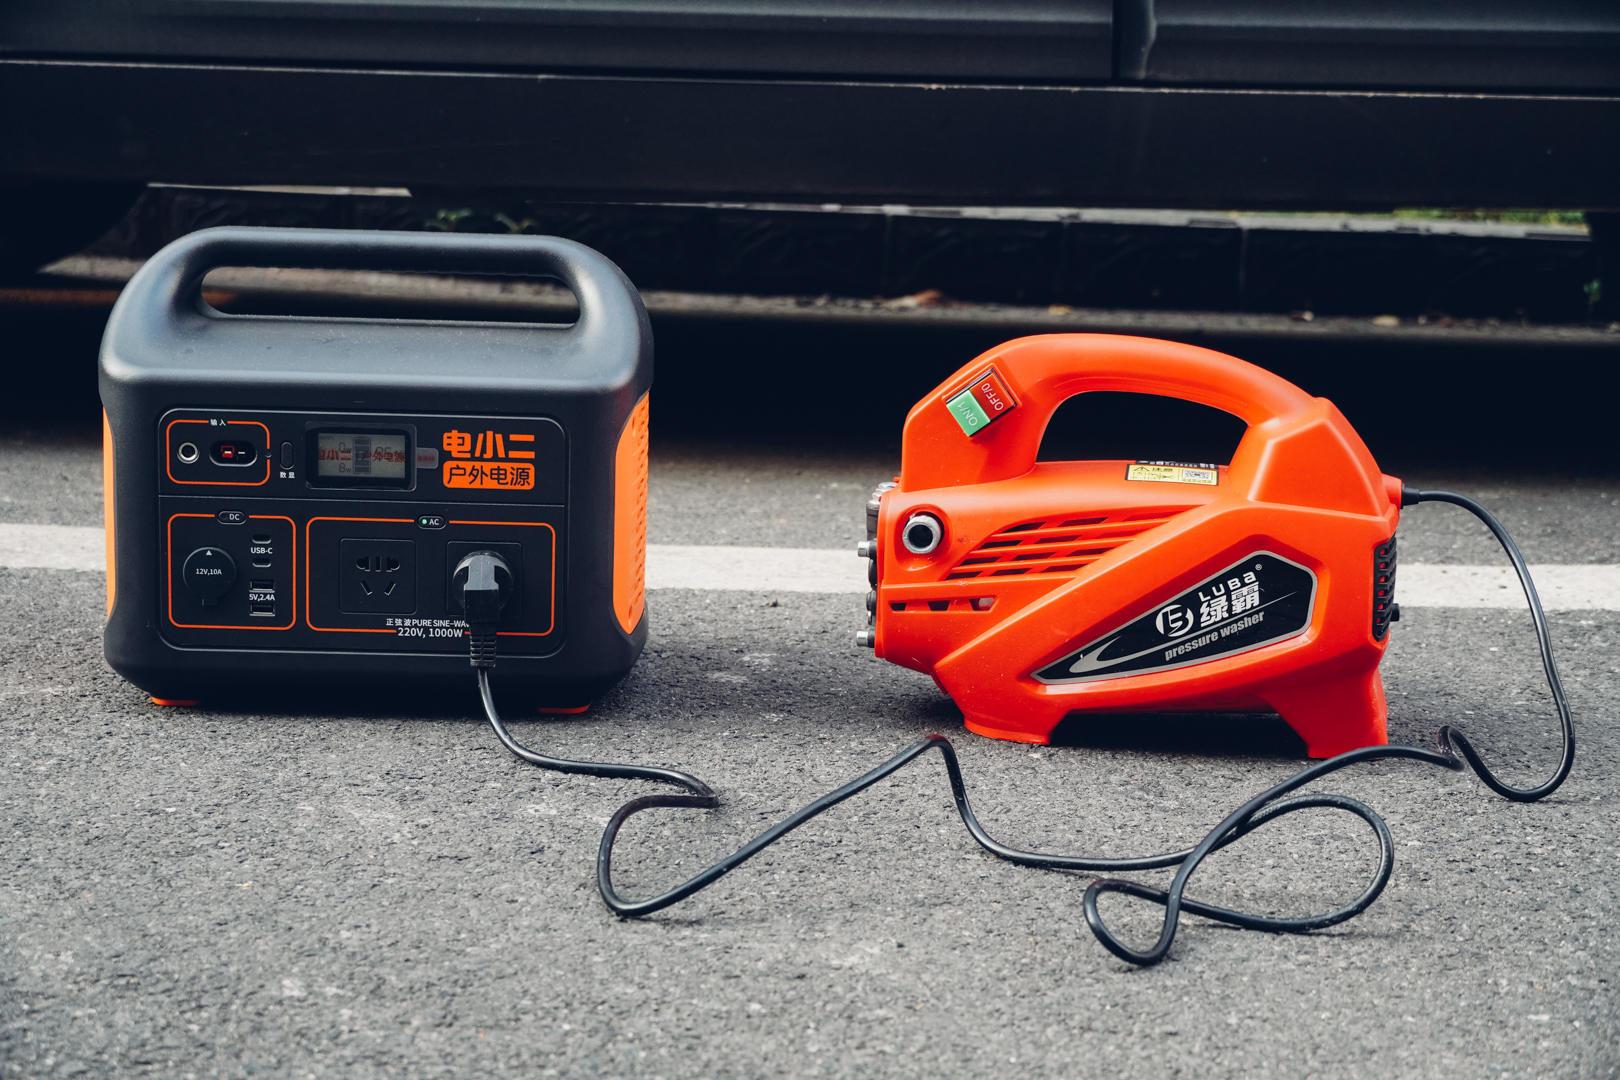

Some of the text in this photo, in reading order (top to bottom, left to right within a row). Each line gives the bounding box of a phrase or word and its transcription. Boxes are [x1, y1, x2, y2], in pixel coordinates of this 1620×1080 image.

[210, 418, 227, 427] 输入
[442, 429, 536, 460] 电小二
[447, 464, 531, 487] 户外电源
[228, 513, 240, 521] DC
[428, 517, 440, 526] AC
[250, 546, 273, 555] USB-C
[195, 568, 223, 576] 12V,10A
[248, 593, 276, 602] 5V,2.4A
[1199, 581, 1260, 628] 绿霸
[412, 619, 432, 627] PURE
[432, 620, 470, 628] SINE-WA
[397, 627, 464, 639] 220V, 1000W
[1164, 611, 1265, 661] pressure washer
